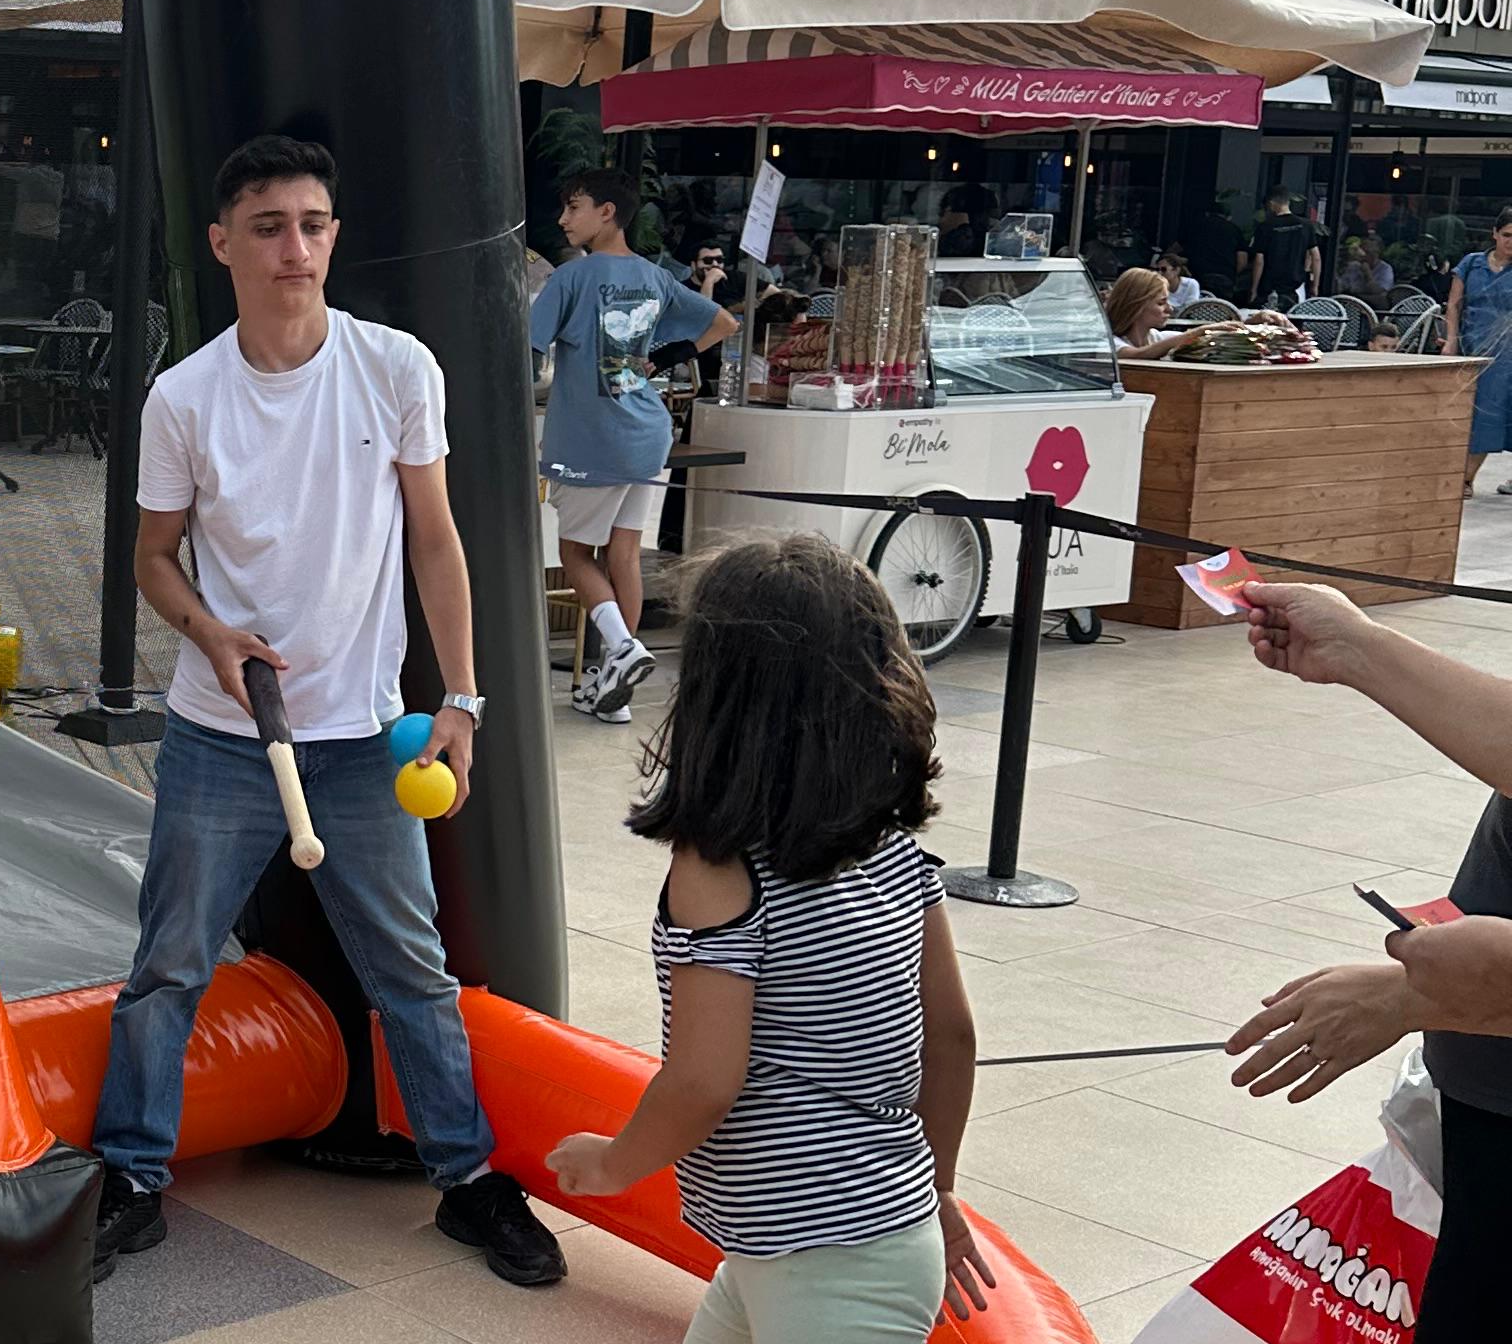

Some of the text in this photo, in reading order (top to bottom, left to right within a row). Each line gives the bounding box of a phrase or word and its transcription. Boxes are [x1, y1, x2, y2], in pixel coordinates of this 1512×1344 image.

[969, 73, 1023, 101] MUÀ
[1023, 80, 1105, 103] Gelatieri
[1456, 89, 1498, 107] midpoint
